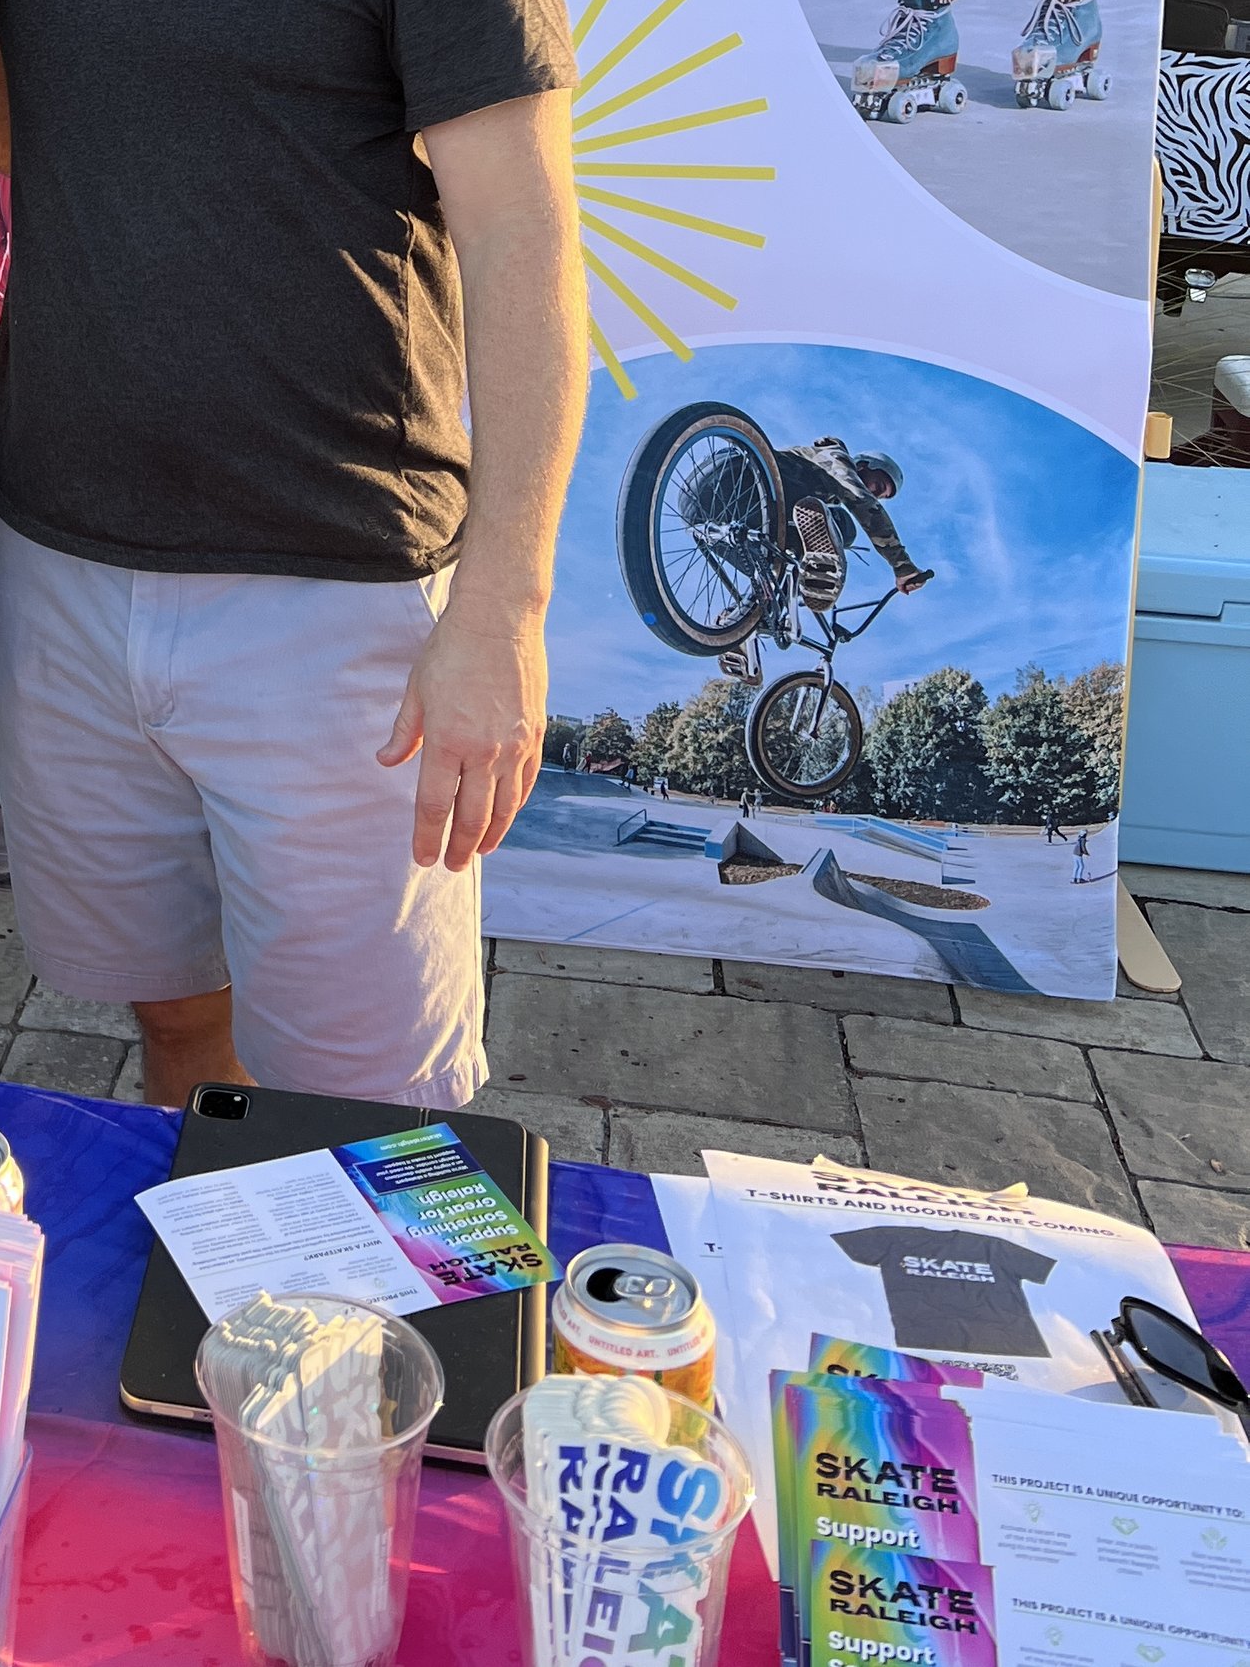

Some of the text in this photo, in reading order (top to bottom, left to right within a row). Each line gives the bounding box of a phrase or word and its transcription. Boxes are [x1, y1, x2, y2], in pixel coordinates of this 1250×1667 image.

[418, 1182, 487, 1206] Raleigh
[418, 1196, 497, 1222] Great for
[406, 1209, 509, 1239] Something
[746, 1188, 1121, 1238] T-SHIRTS AND HOODIES ARE COMING.
[362, 1239, 383, 1249] WHY
[444, 1223, 520, 1248] Support
[303, 1245, 354, 1262] SKATEPARK?
[427, 1242, 532, 1272] RALEIGH
[901, 1255, 993, 1275] SKATE
[436, 1252, 544, 1287] SKATE
[904, 1268, 996, 1284] RALEIGH
[365, 1288, 419, 1305] THIS PROJEC
[588, 1335, 633, 1357] UNTITLED
[636, 1348, 660, 1359] ART.
[815, 1451, 959, 1495] SKATE
[816, 1481, 962, 1515] RALEIGH
[991, 1473, 1018, 1486] THIS
[1019, 1477, 1071, 1493] PROJECT
[1072, 1484, 1084, 1495] IS
[1085, 1486, 1095, 1496] A
[1096, 1488, 1140, 1504] UNIQUE
[1141, 1495, 1223, 1516] OPPORTUNITY
[815, 1516, 920, 1549] Support
[828, 1569, 977, 1616] SKATE
[829, 1598, 980, 1635] RALEIGH
[1011, 1598, 1250, 1649] THIS PROJECT IS A UNIQUE OPPORTUNITY
[827, 1630, 937, 1665] Support
